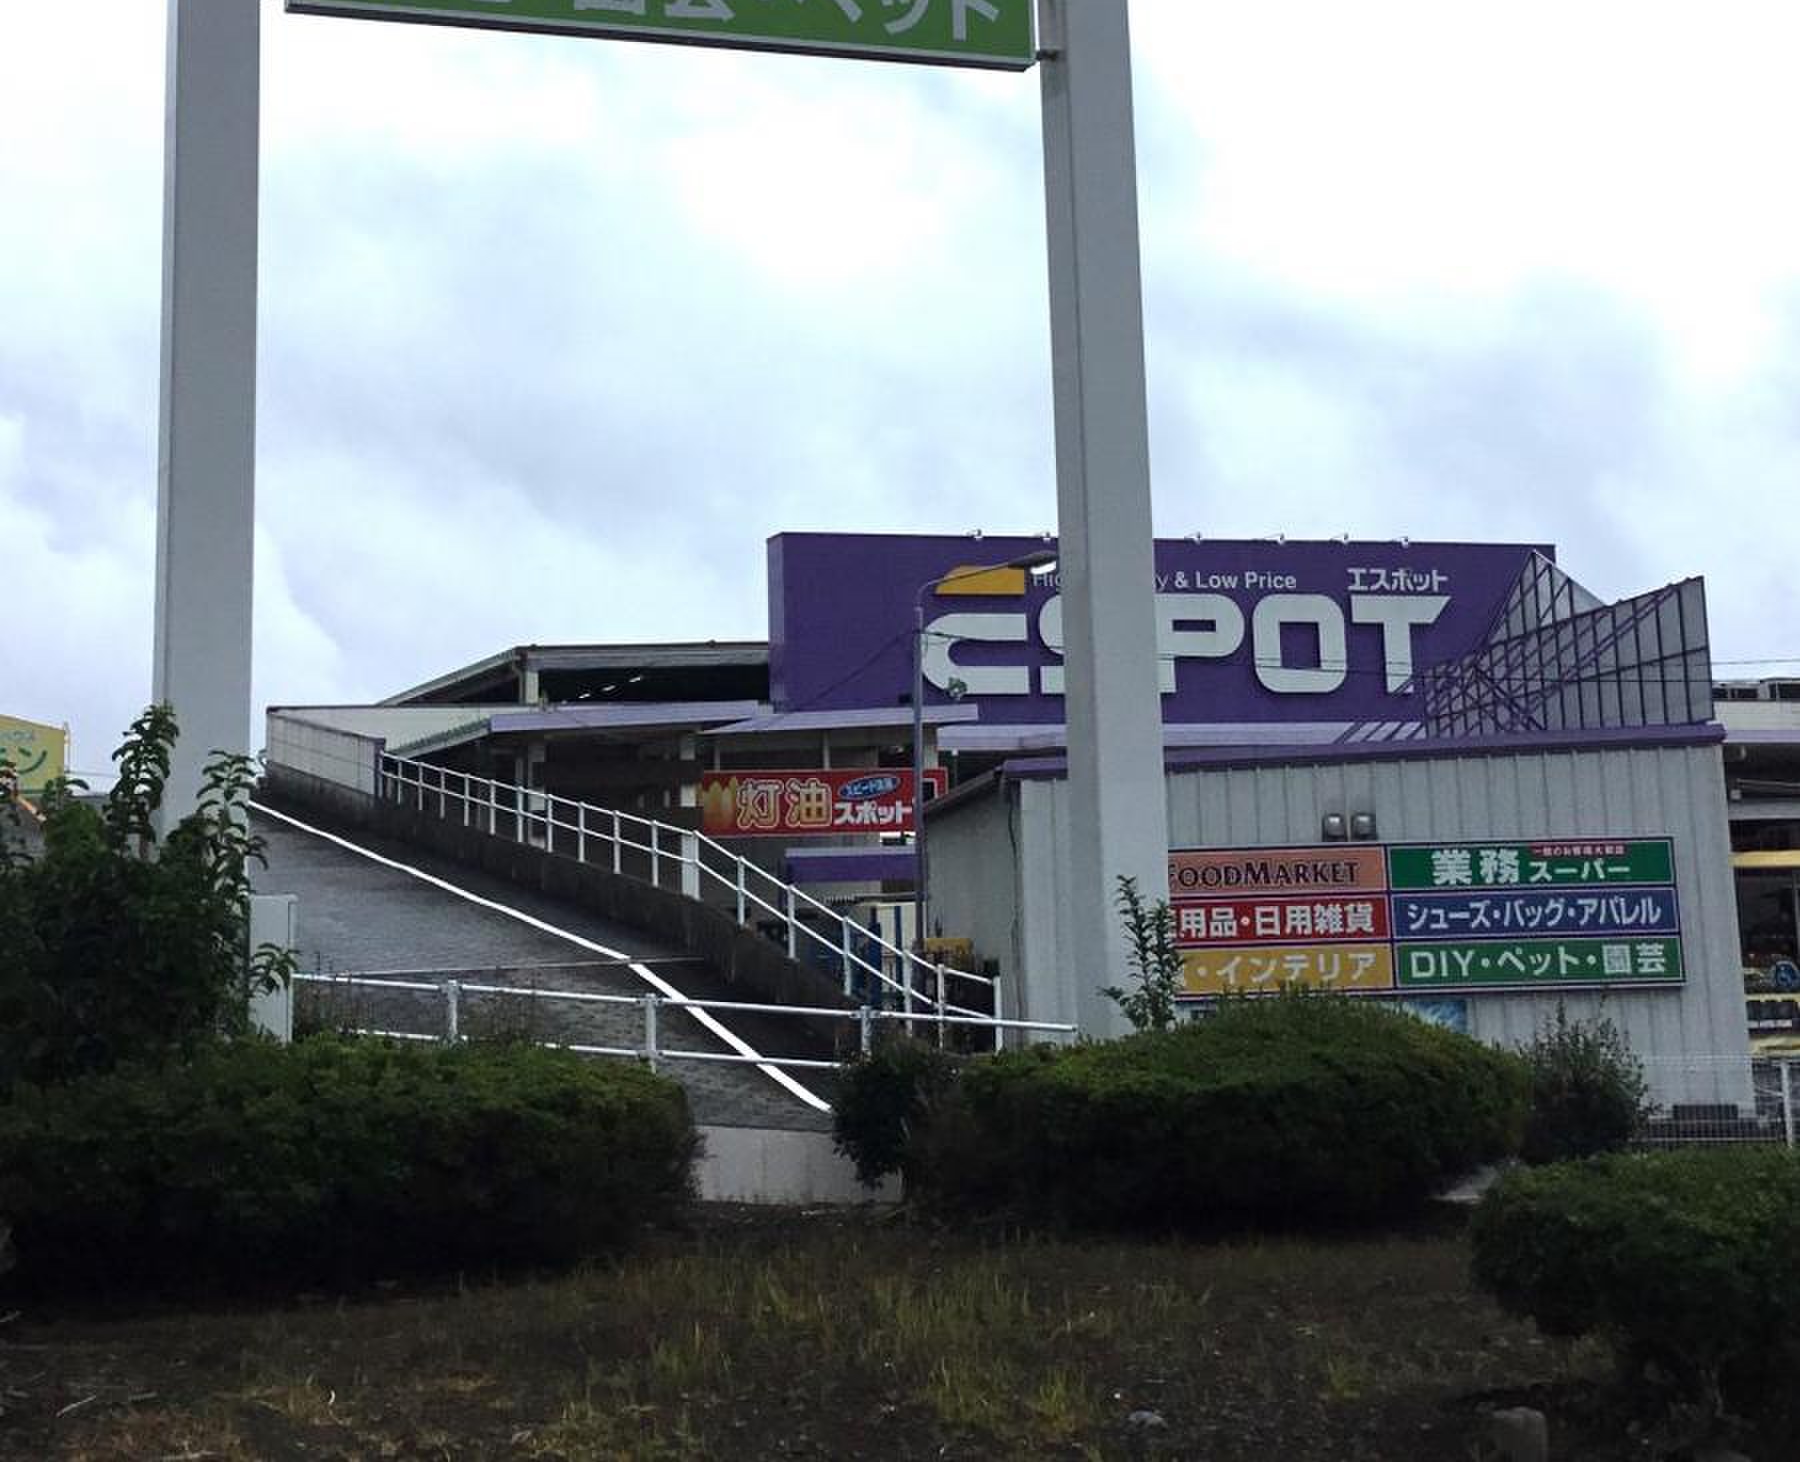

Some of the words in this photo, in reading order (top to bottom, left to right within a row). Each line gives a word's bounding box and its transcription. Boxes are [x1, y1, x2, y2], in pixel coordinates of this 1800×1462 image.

[1174, 571, 1189, 588] &
[1196, 571, 1238, 589] Low
[1244, 571, 1297, 589] Price
[1346, 568, 1449, 592] エスポット
[736, 778, 832, 830] 灯油
[834, 800, 913, 825] スポット
[1407, 897, 1662, 930] シューズ・バッグ・アパレル
[1410, 943, 1666, 978] DIY・ペット・園芸
